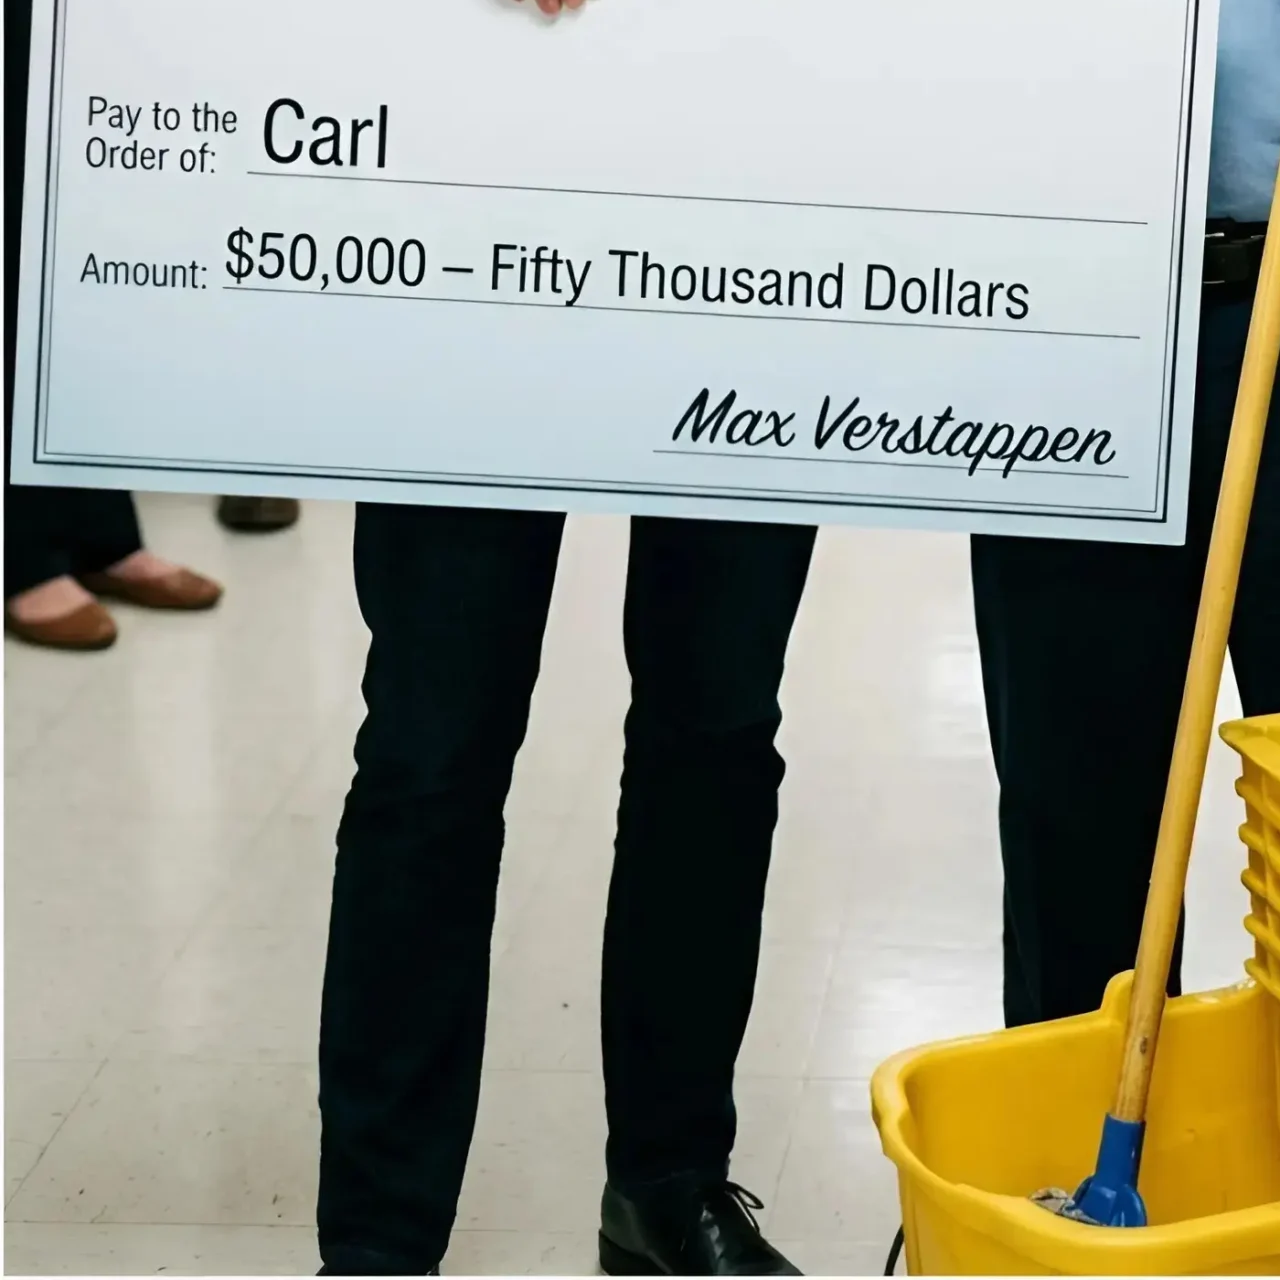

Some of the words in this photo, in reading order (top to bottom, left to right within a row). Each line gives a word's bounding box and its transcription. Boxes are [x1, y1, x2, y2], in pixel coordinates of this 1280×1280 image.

[88, 95, 142, 137] Pay
[152, 102, 181, 131] to
[191, 102, 238, 134] the
[263, 97, 388, 169] Carl
[85, 136, 170, 171] Order
[179, 142, 216, 173] of:
[79, 252, 208, 290] Amount:
[225, 226, 426, 291] $50,000
[491, 243, 592, 308] Fifty
[608, 249, 844, 309] Thousand
[864, 263, 1029, 320] Dollars
[671, 387, 796, 448] Max
[814, 395, 1116, 479] Verstappen
